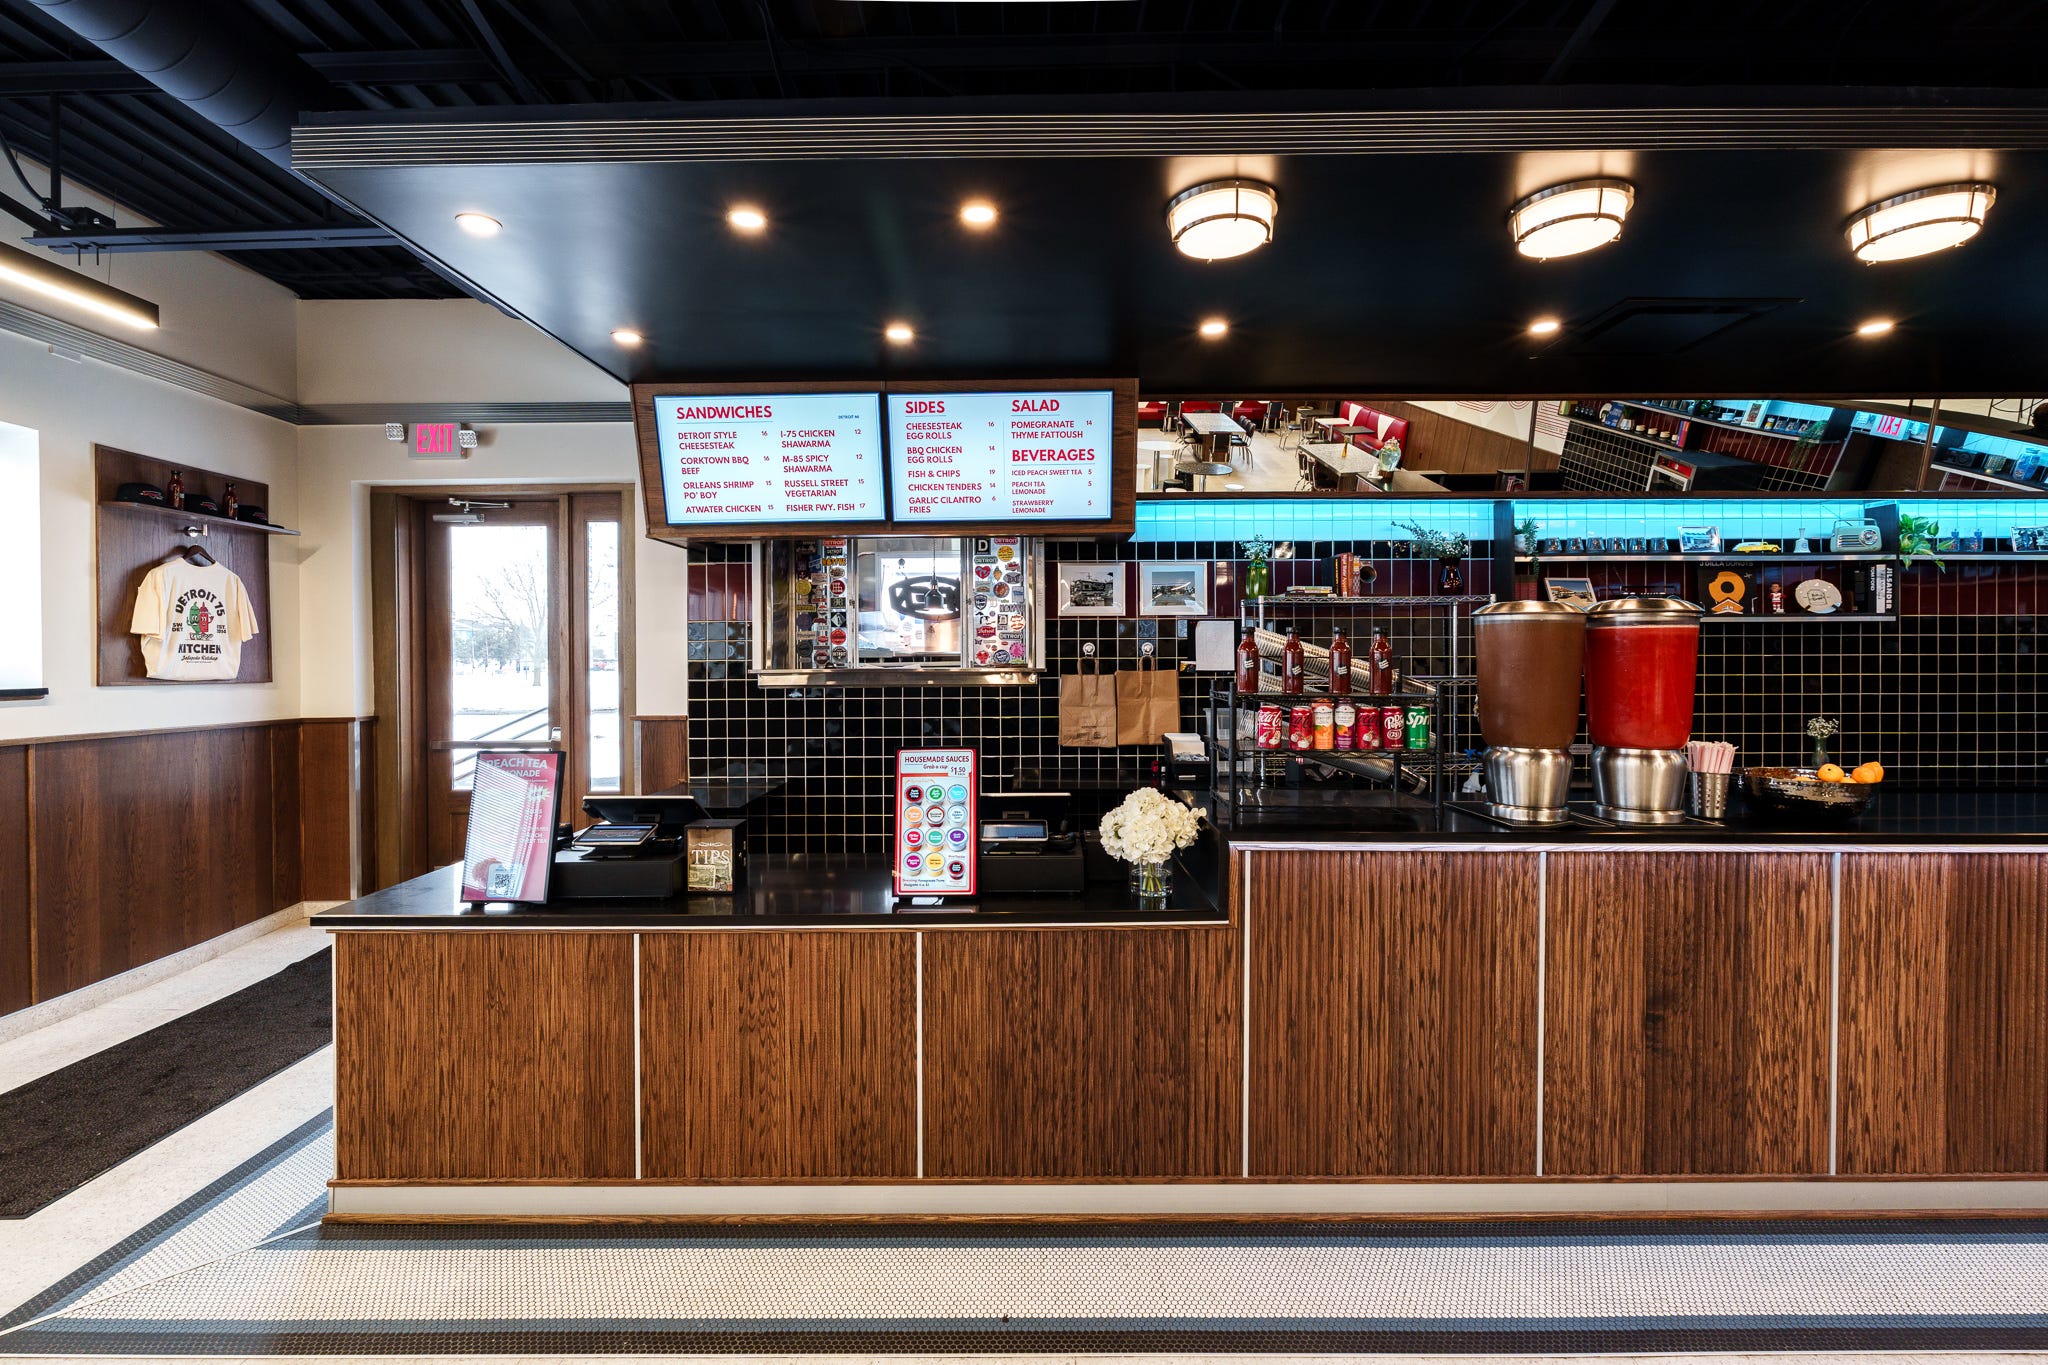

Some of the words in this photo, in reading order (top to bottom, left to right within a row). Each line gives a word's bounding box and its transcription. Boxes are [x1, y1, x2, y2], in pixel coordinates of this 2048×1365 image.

[906, 401, 945, 413] SIDES
[1012, 399, 1059, 412] SALAD
[677, 406, 772, 419] SANDWICHES
[906, 422, 962, 430] CHEESESTEAK
[416, 423, 455, 453] EXIT
[679, 442, 734, 450] CHEESESTEAK
[782, 440, 831, 448] SHAWARMA
[907, 447, 924, 456] BBQ
[926, 446, 962, 454] CHICKEN
[1012, 449, 1095, 461] BEVERAGES
[732, 456, 749, 464] BBQ
[908, 455, 924, 463] EGG
[175, 588, 217, 614] DETROIT
[214, 601, 225, 617] 75
[178, 643, 222, 654] KITCHEN
[527, 759, 548, 769] TEA
[692, 850, 730, 865] TIPS
